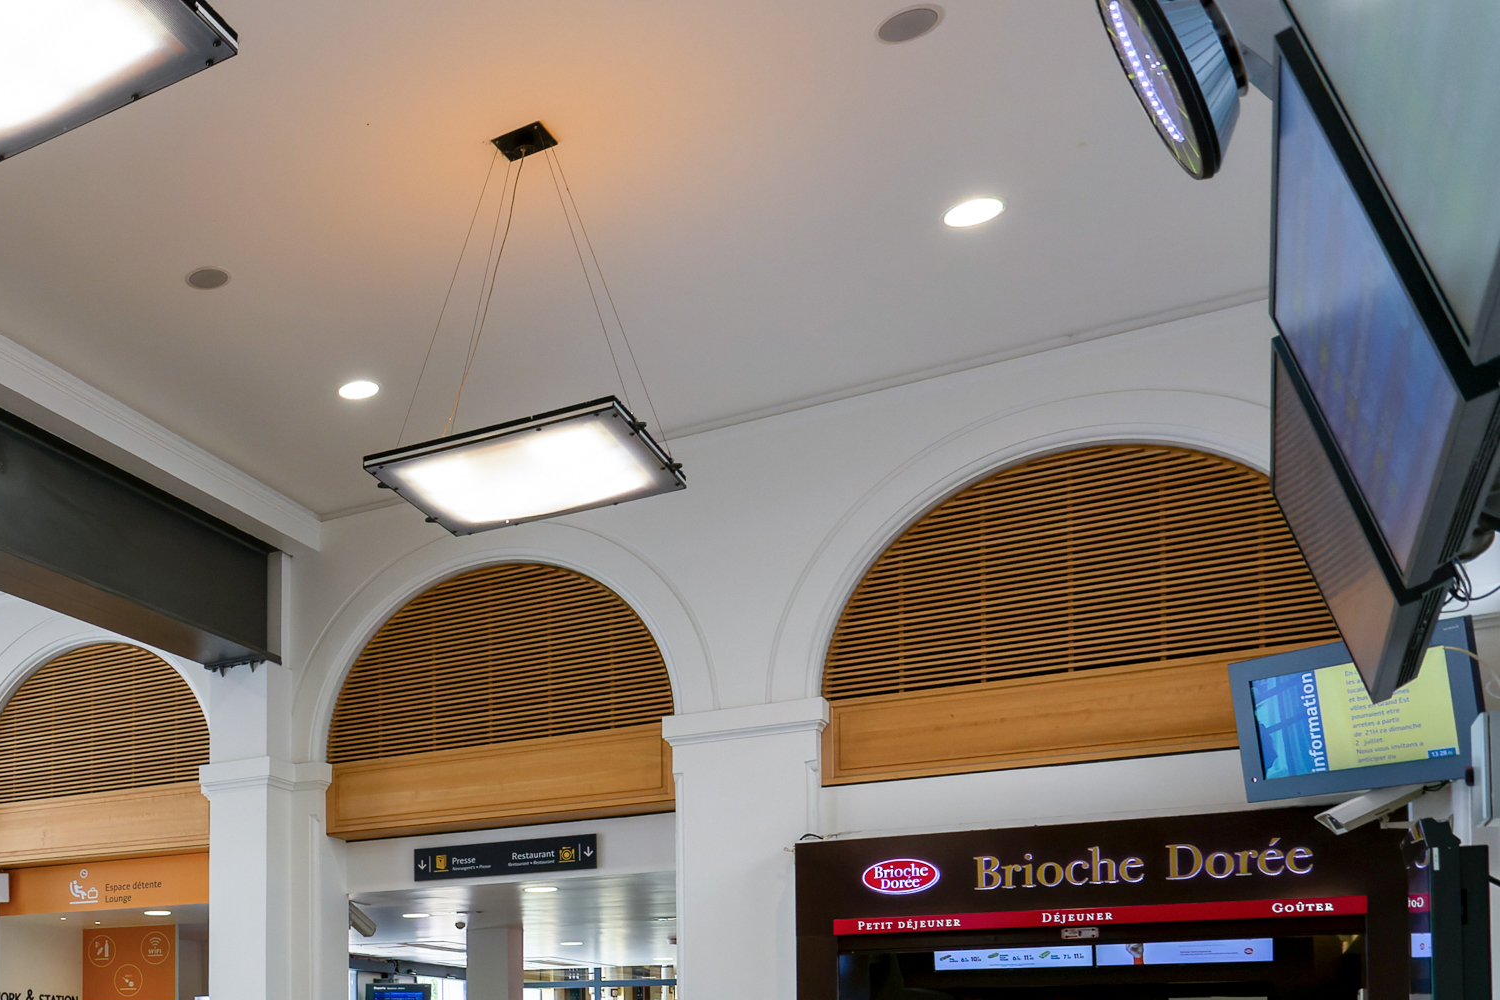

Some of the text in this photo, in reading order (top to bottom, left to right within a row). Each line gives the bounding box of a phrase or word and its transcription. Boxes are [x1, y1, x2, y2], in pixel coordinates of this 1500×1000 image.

[1352, 710, 1384, 720] pourraient
[1301, 672, 1327, 773] information
[1382, 717, 1400, 725] partir
[1389, 723, 1422, 732] dimanche
[512, 850, 555, 860] Restaurant
[452, 857, 476, 865] Presse
[973, 837, 1314, 890] Brioche Dorée
[874, 863, 929, 879] Brioche
[105, 881, 162, 892] Espace détente
[880, 876, 920, 890] Dorée
[105, 895, 132, 904] Lounge
[1272, 902, 1334, 913] GOÛTER
[1042, 912, 1113, 924] DÉJEUNER
[858, 919, 961, 930] PETIT DÉJEUNER
